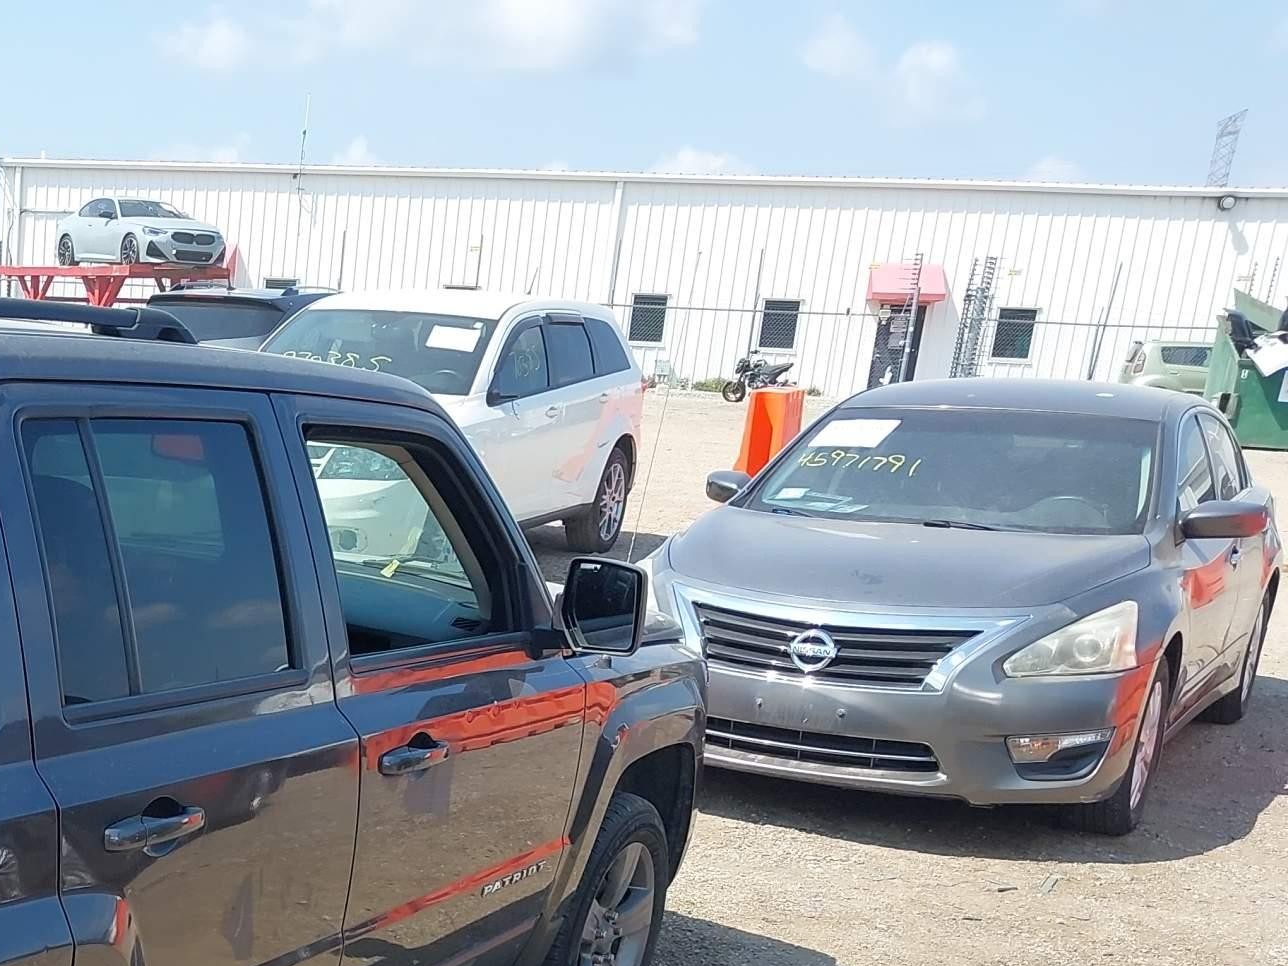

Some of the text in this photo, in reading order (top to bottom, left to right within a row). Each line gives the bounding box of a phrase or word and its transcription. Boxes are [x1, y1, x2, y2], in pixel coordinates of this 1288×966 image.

[798, 450, 922, 477] 45971791
[793, 645, 831, 656] NISSAN
[482, 860, 547, 897] PATRIOT
